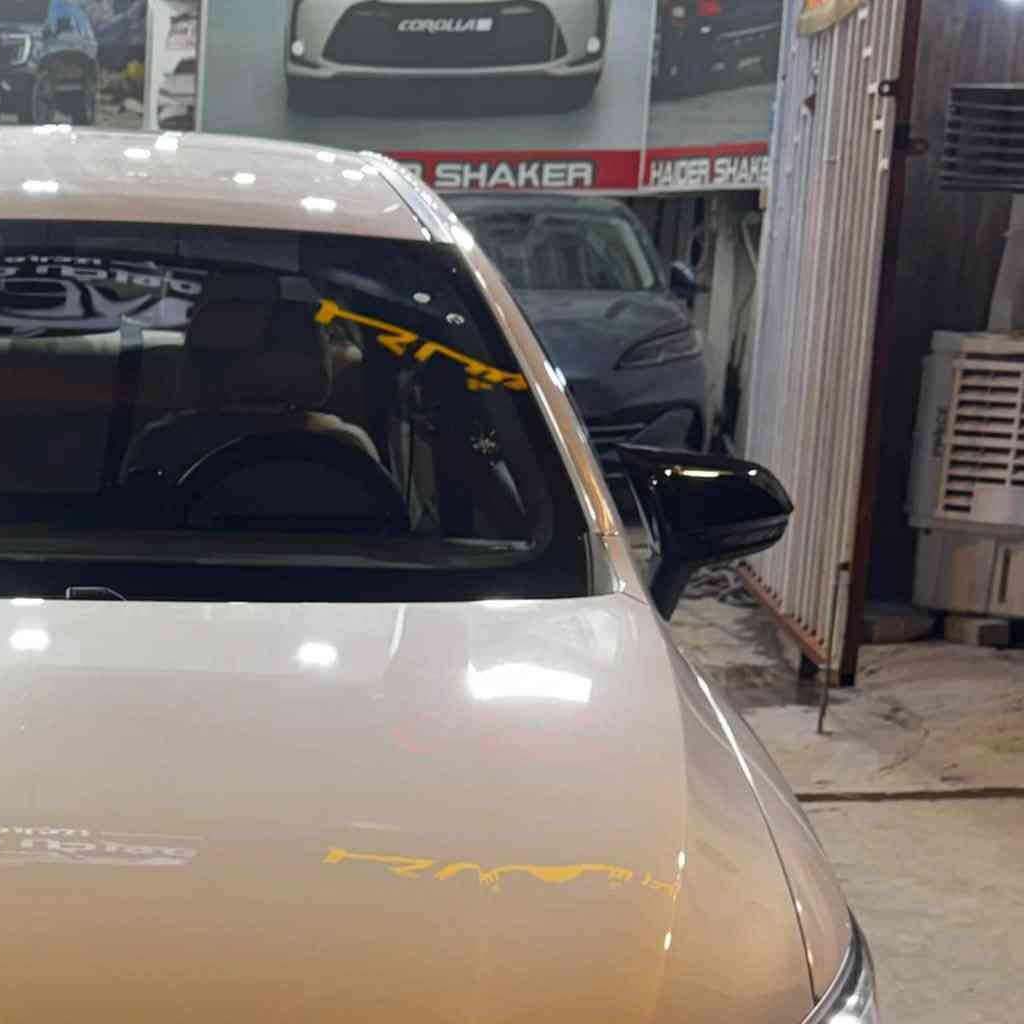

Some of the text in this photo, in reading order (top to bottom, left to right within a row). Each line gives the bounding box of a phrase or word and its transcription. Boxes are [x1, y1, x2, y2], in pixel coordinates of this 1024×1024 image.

[434, 160, 593, 189] SHAKER
[650, 154, 769, 186] HAIDER SHAKE
